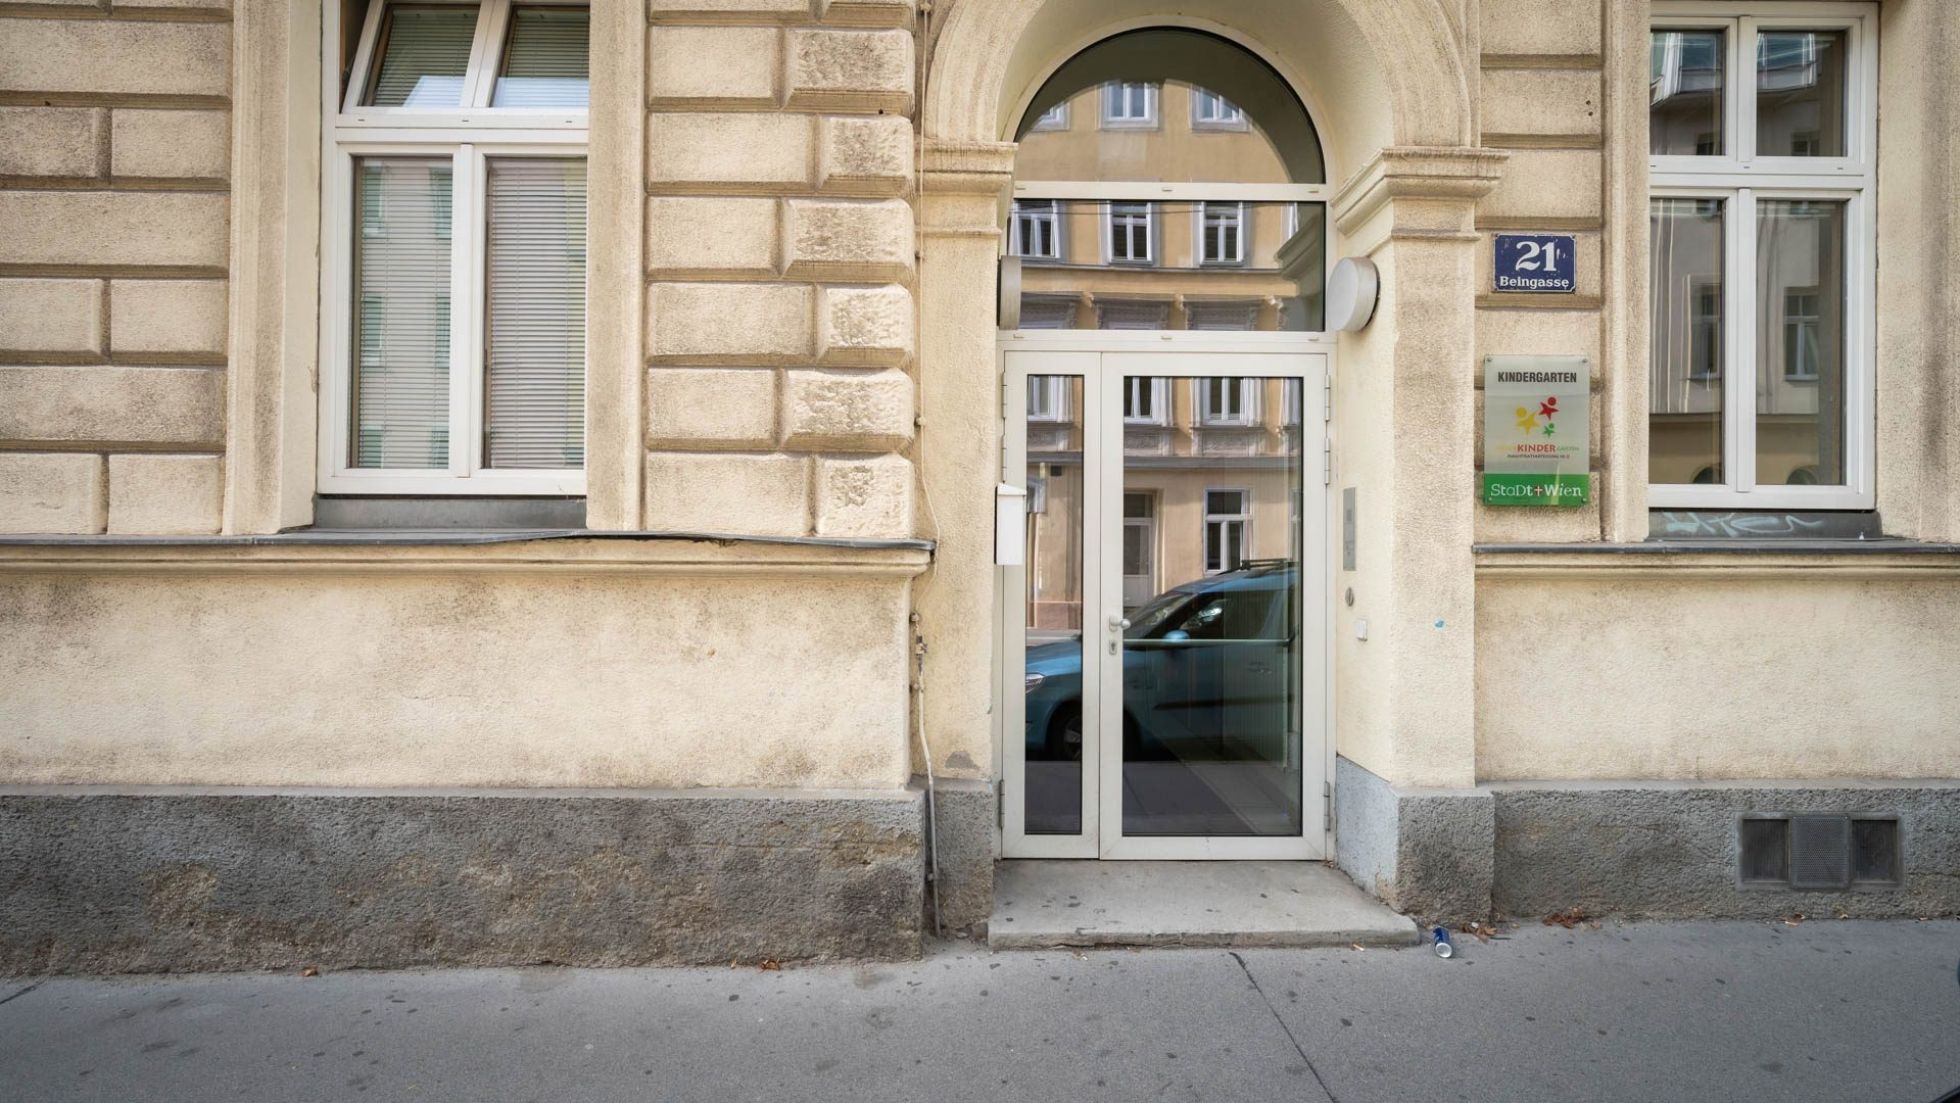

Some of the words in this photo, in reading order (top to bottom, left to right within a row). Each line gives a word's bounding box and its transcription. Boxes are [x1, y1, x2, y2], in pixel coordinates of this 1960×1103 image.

[1515, 241, 1557, 271] 21
[1500, 276, 1569, 289] Beingasse
[1498, 371, 1577, 383] KINDERGARTEN
